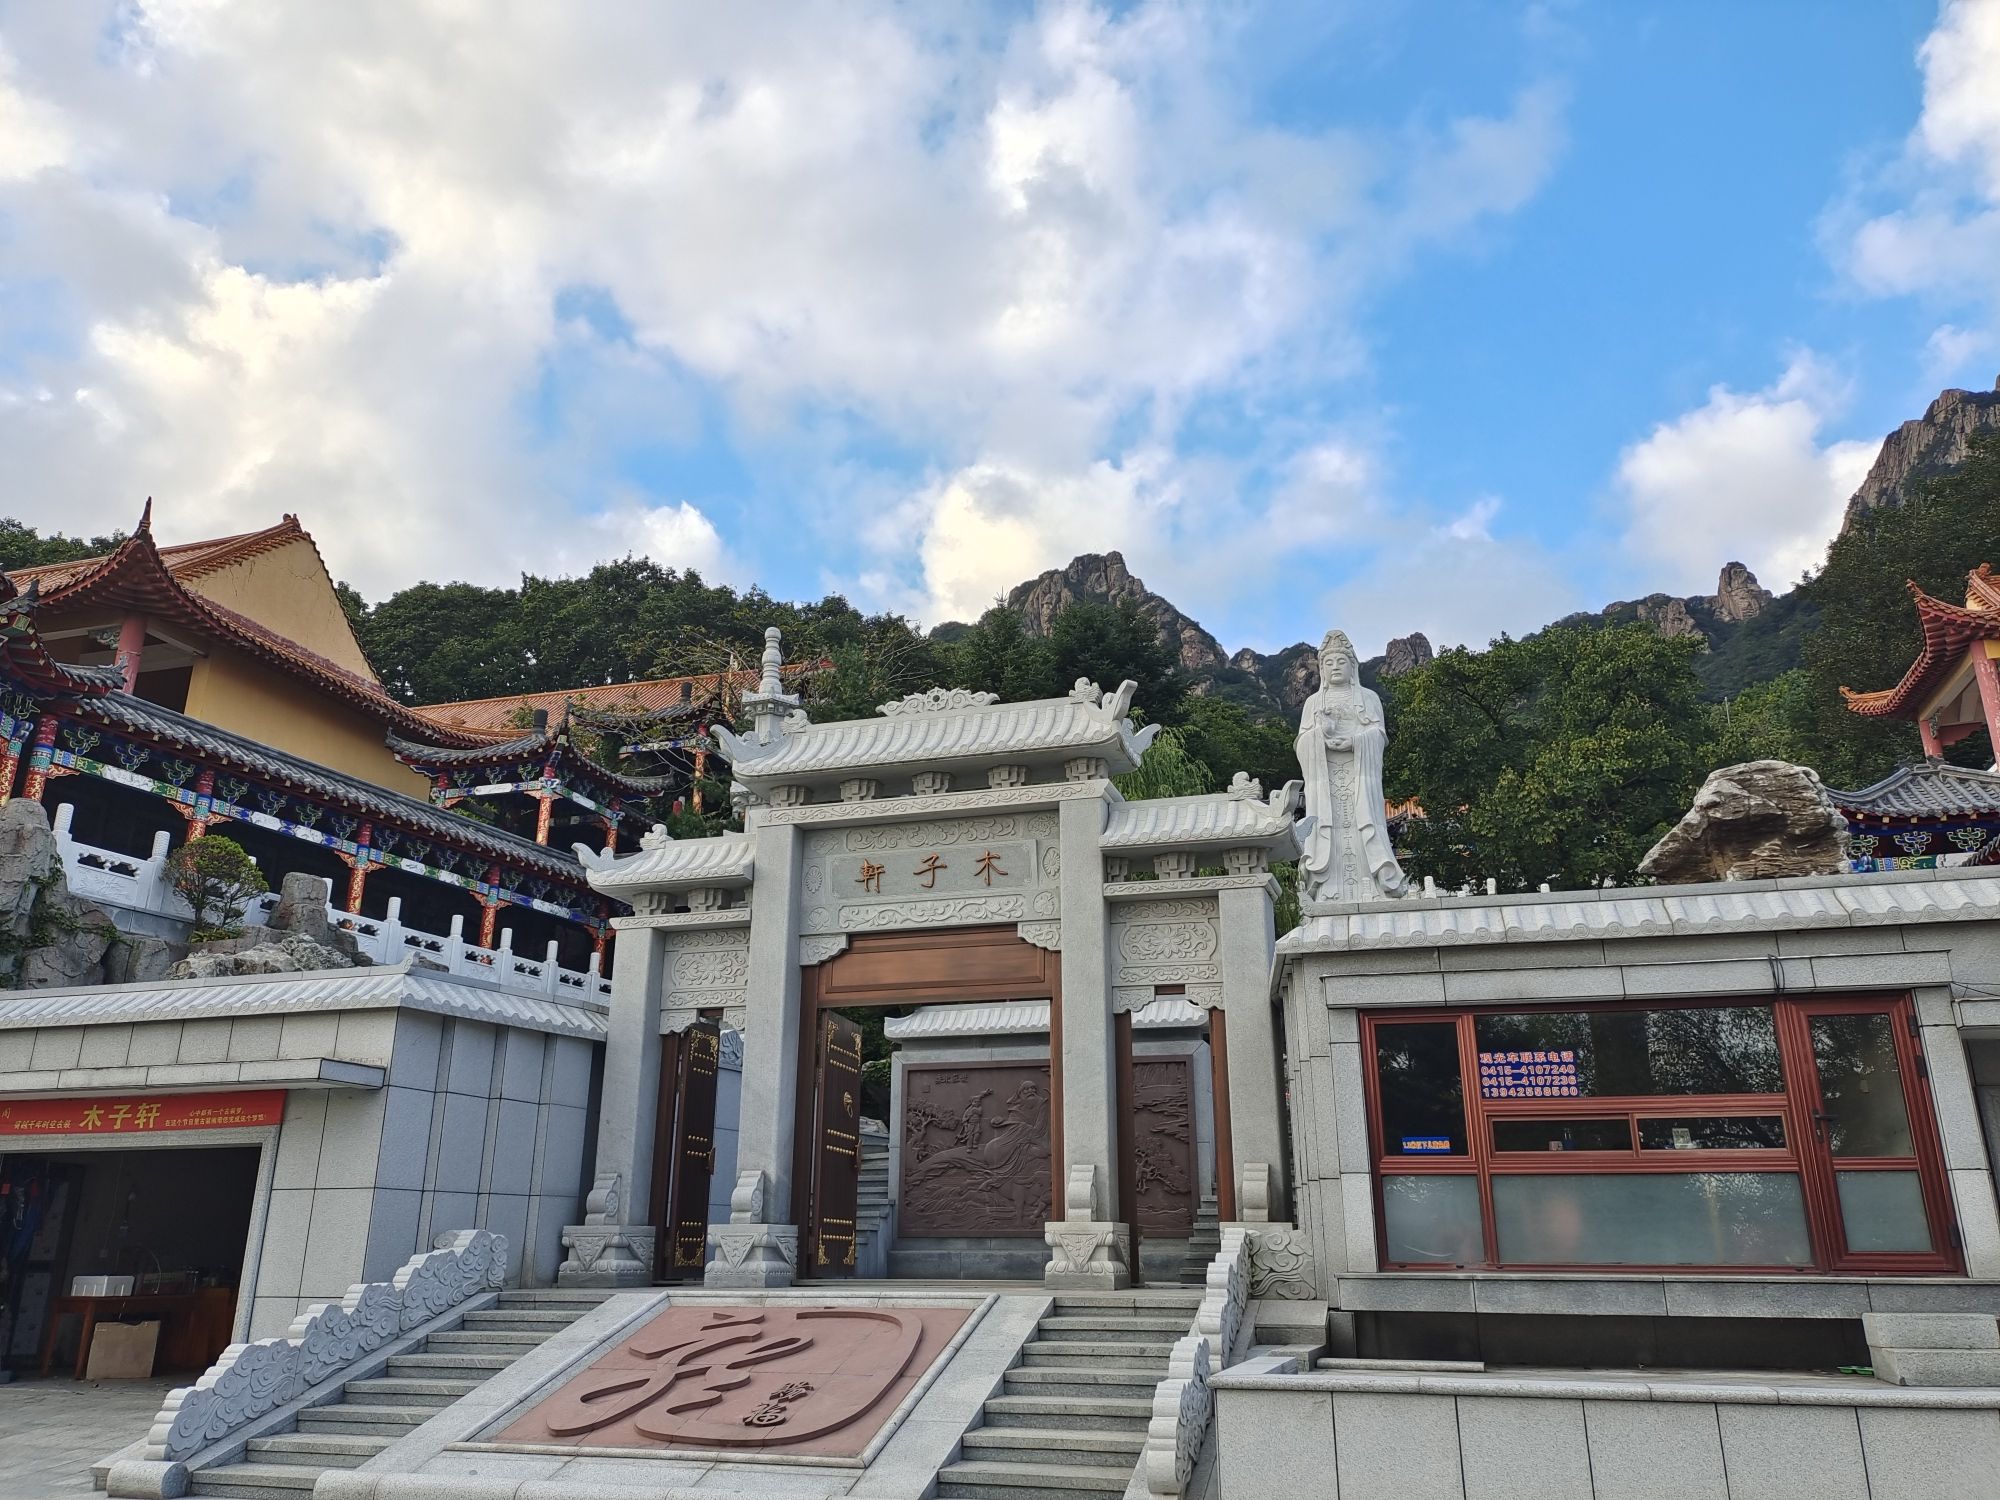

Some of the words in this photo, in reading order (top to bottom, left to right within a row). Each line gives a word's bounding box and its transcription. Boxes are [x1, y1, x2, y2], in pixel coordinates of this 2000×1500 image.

[1480, 1051, 1574, 1064] 观光车联系电话
[78, 1102, 162, 1131] 木子轩
